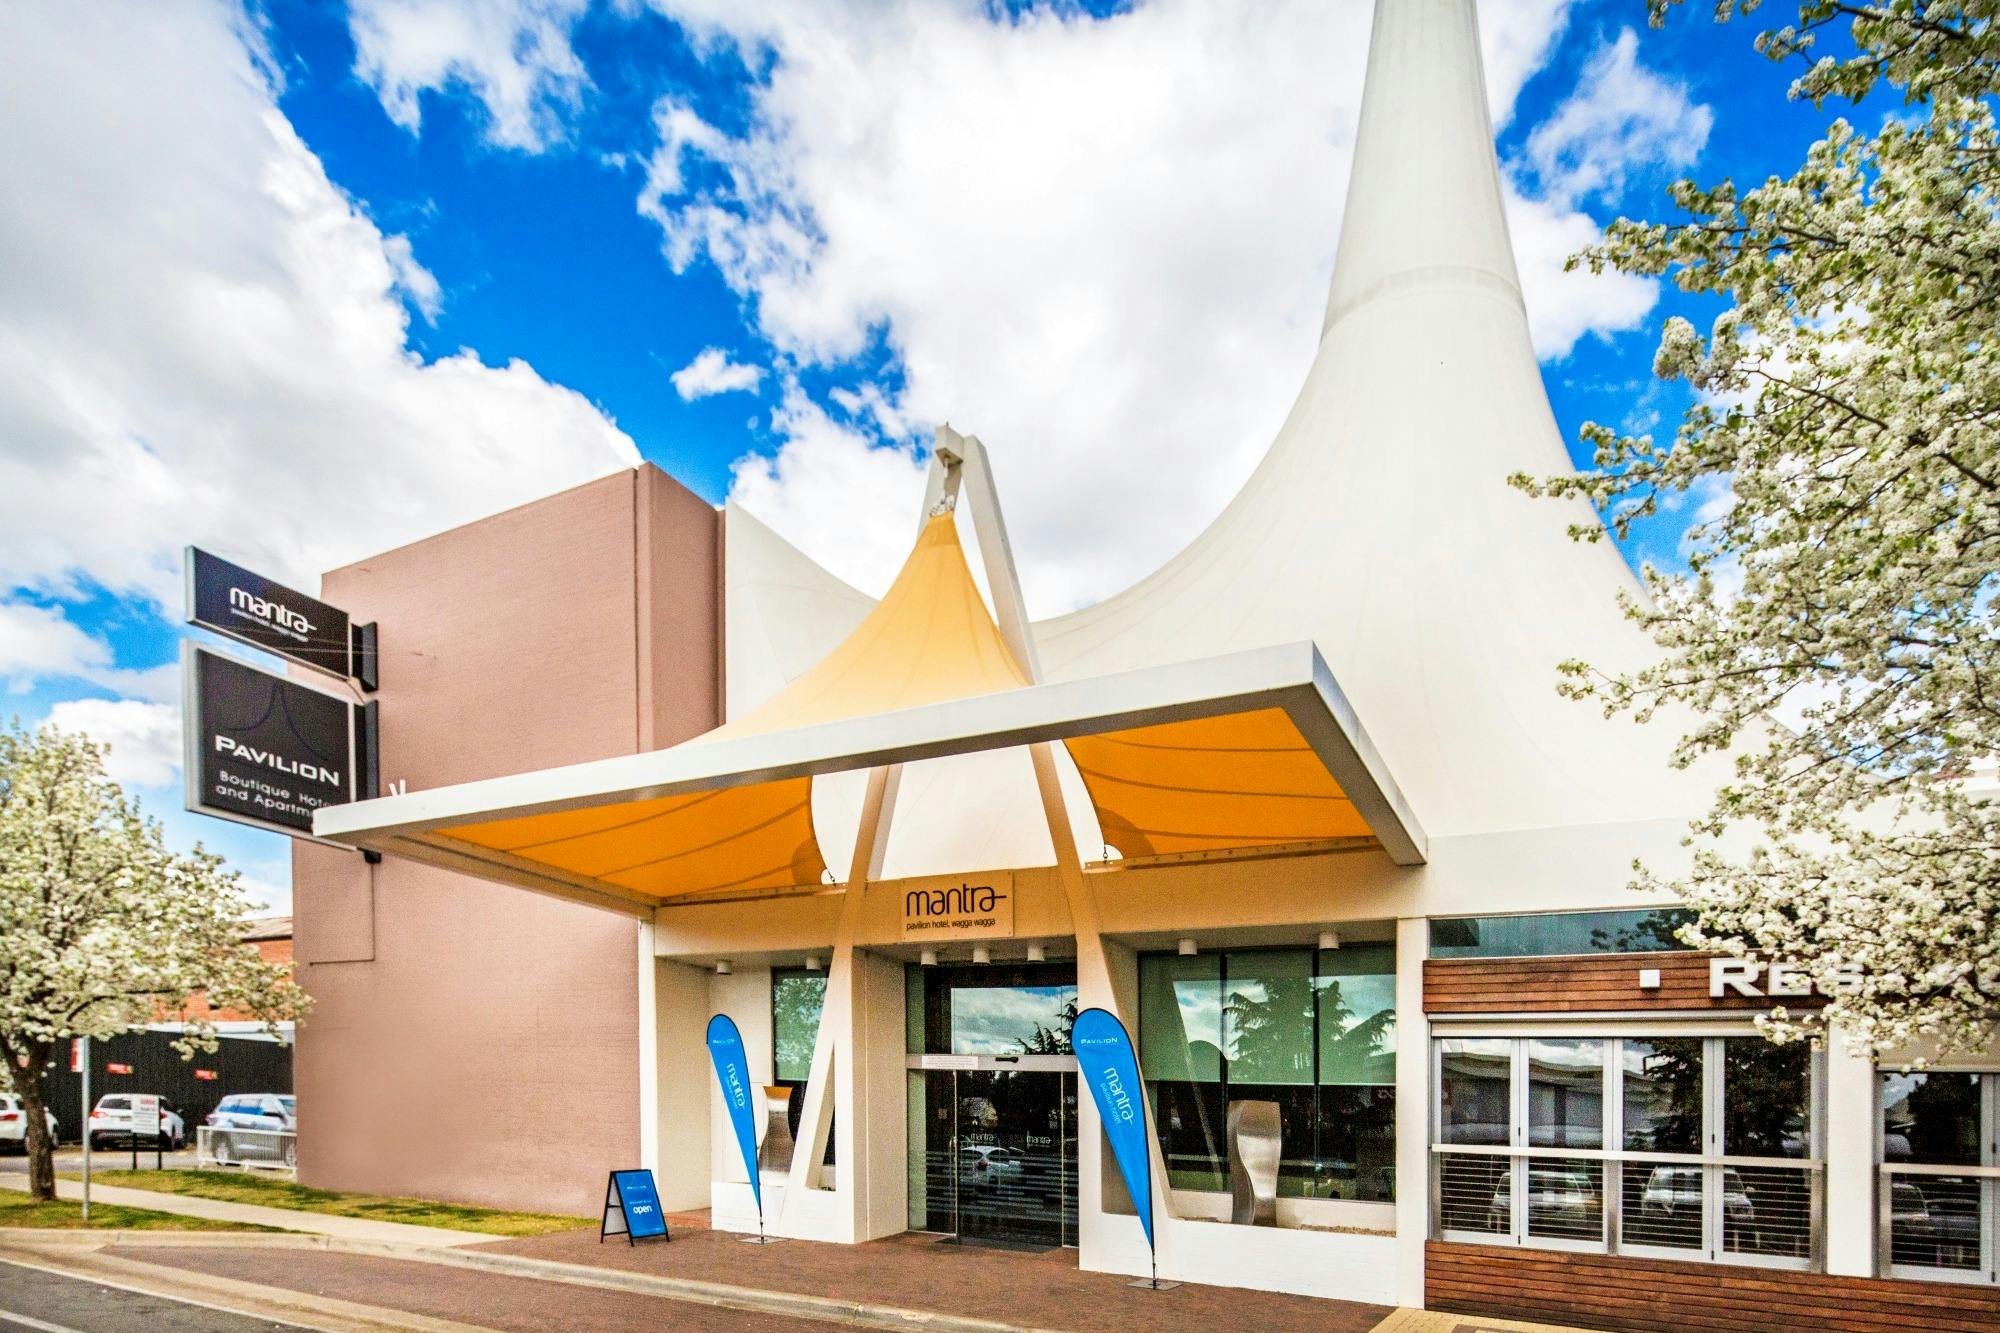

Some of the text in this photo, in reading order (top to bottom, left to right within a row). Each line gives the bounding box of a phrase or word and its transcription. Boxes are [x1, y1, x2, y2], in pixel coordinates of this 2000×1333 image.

[230, 587, 317, 633] mantra
[215, 734, 340, 787] PAVILION
[215, 784, 313, 817] and Apartm
[220, 769, 290, 799] Boutique
[906, 883, 1007, 917] mantra
[906, 920, 931, 932] pavilion
[951, 919, 973, 929] wagga
[974, 917, 996, 928] wagga
[1080, 1037, 1118, 1045] PAVILION
[726, 1063, 746, 1110] mantra
[1103, 1067, 1134, 1125] mantra
[633, 1205, 653, 1215] open
